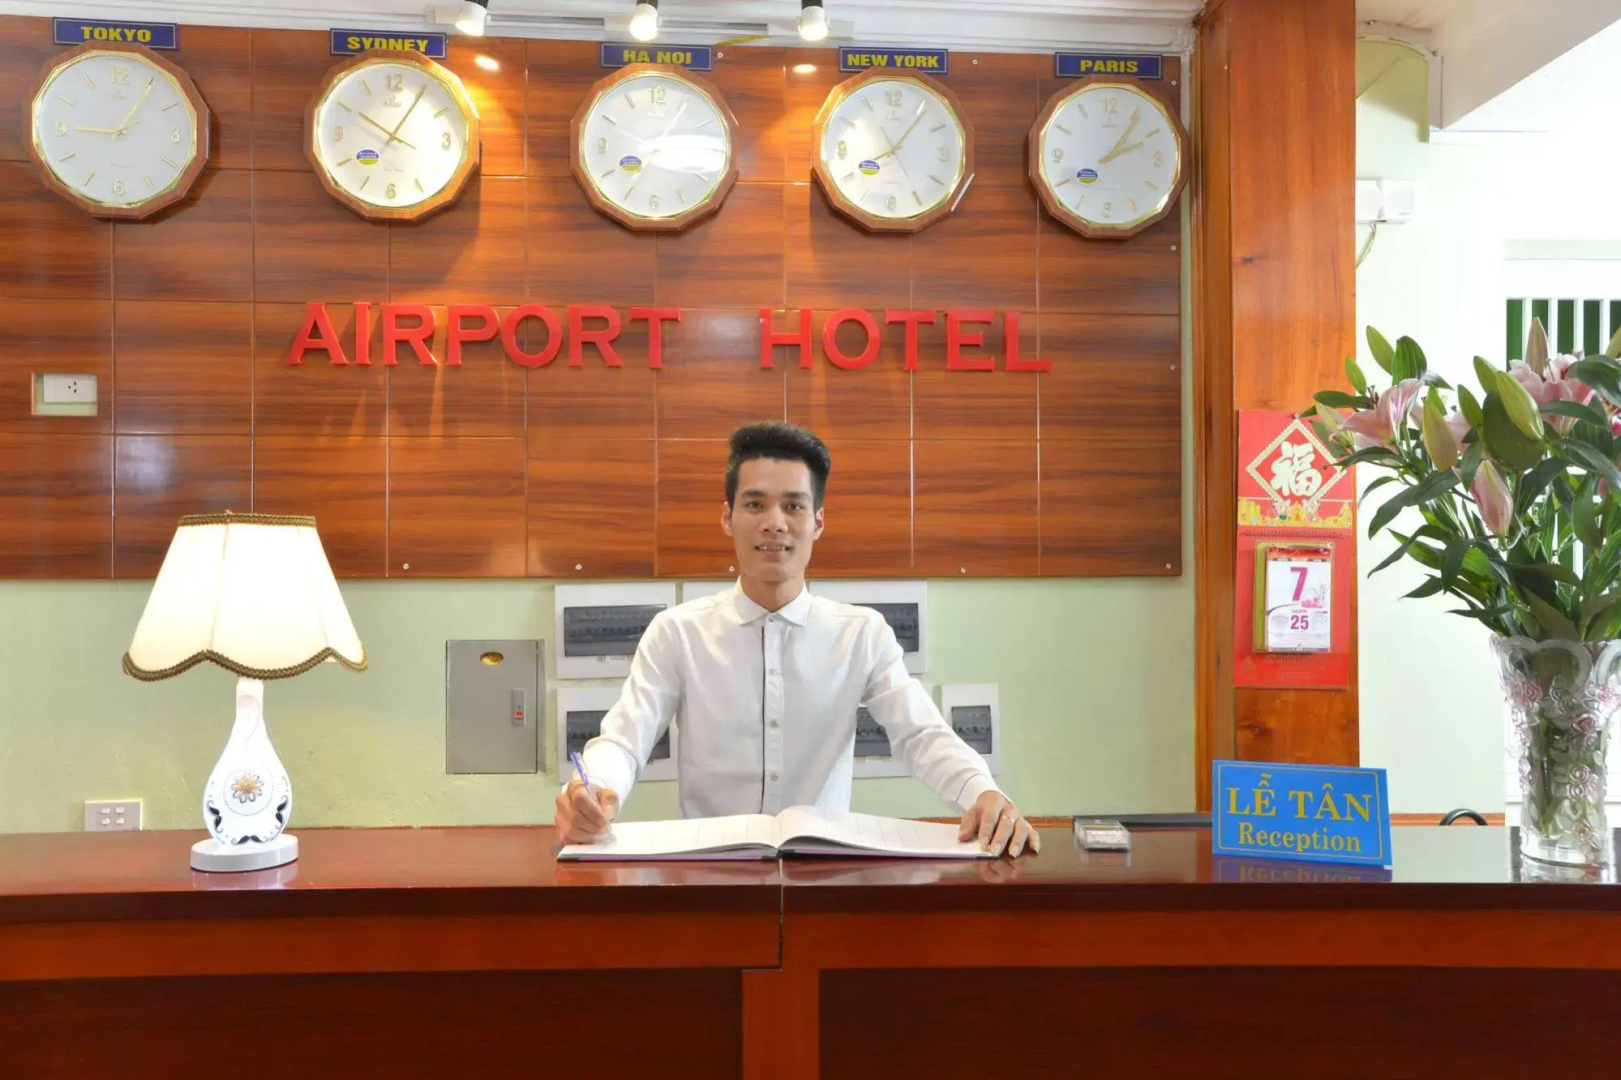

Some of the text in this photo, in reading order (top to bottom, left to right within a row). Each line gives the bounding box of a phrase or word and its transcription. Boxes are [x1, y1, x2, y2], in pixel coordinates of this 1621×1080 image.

[81, 26, 152, 43] TOKYO
[347, 36, 429, 52] SYDNEY
[623, 49, 692, 66] HA NOI
[847, 53, 938, 69] NEW YORK
[1080, 59, 1138, 73] PARIS
[109, 66, 129, 84] 12
[385, 74, 403, 91] 12
[649, 86, 667, 104] 12
[884, 90, 903, 107] 12
[1101, 97, 1118, 114] 12
[170, 127, 181, 143] 3
[442, 132, 452, 151] 3
[386, 183, 396, 200] 6
[286, 301, 1052, 373] AIRPORT HOTEL
[1270, 440, 1323, 497] 福
[1290, 566, 1308, 601] 7
[1290, 615, 1309, 630] 25
[1226, 772, 1372, 822] LỄ TÂN
[1238, 822, 1362, 853] Reception
